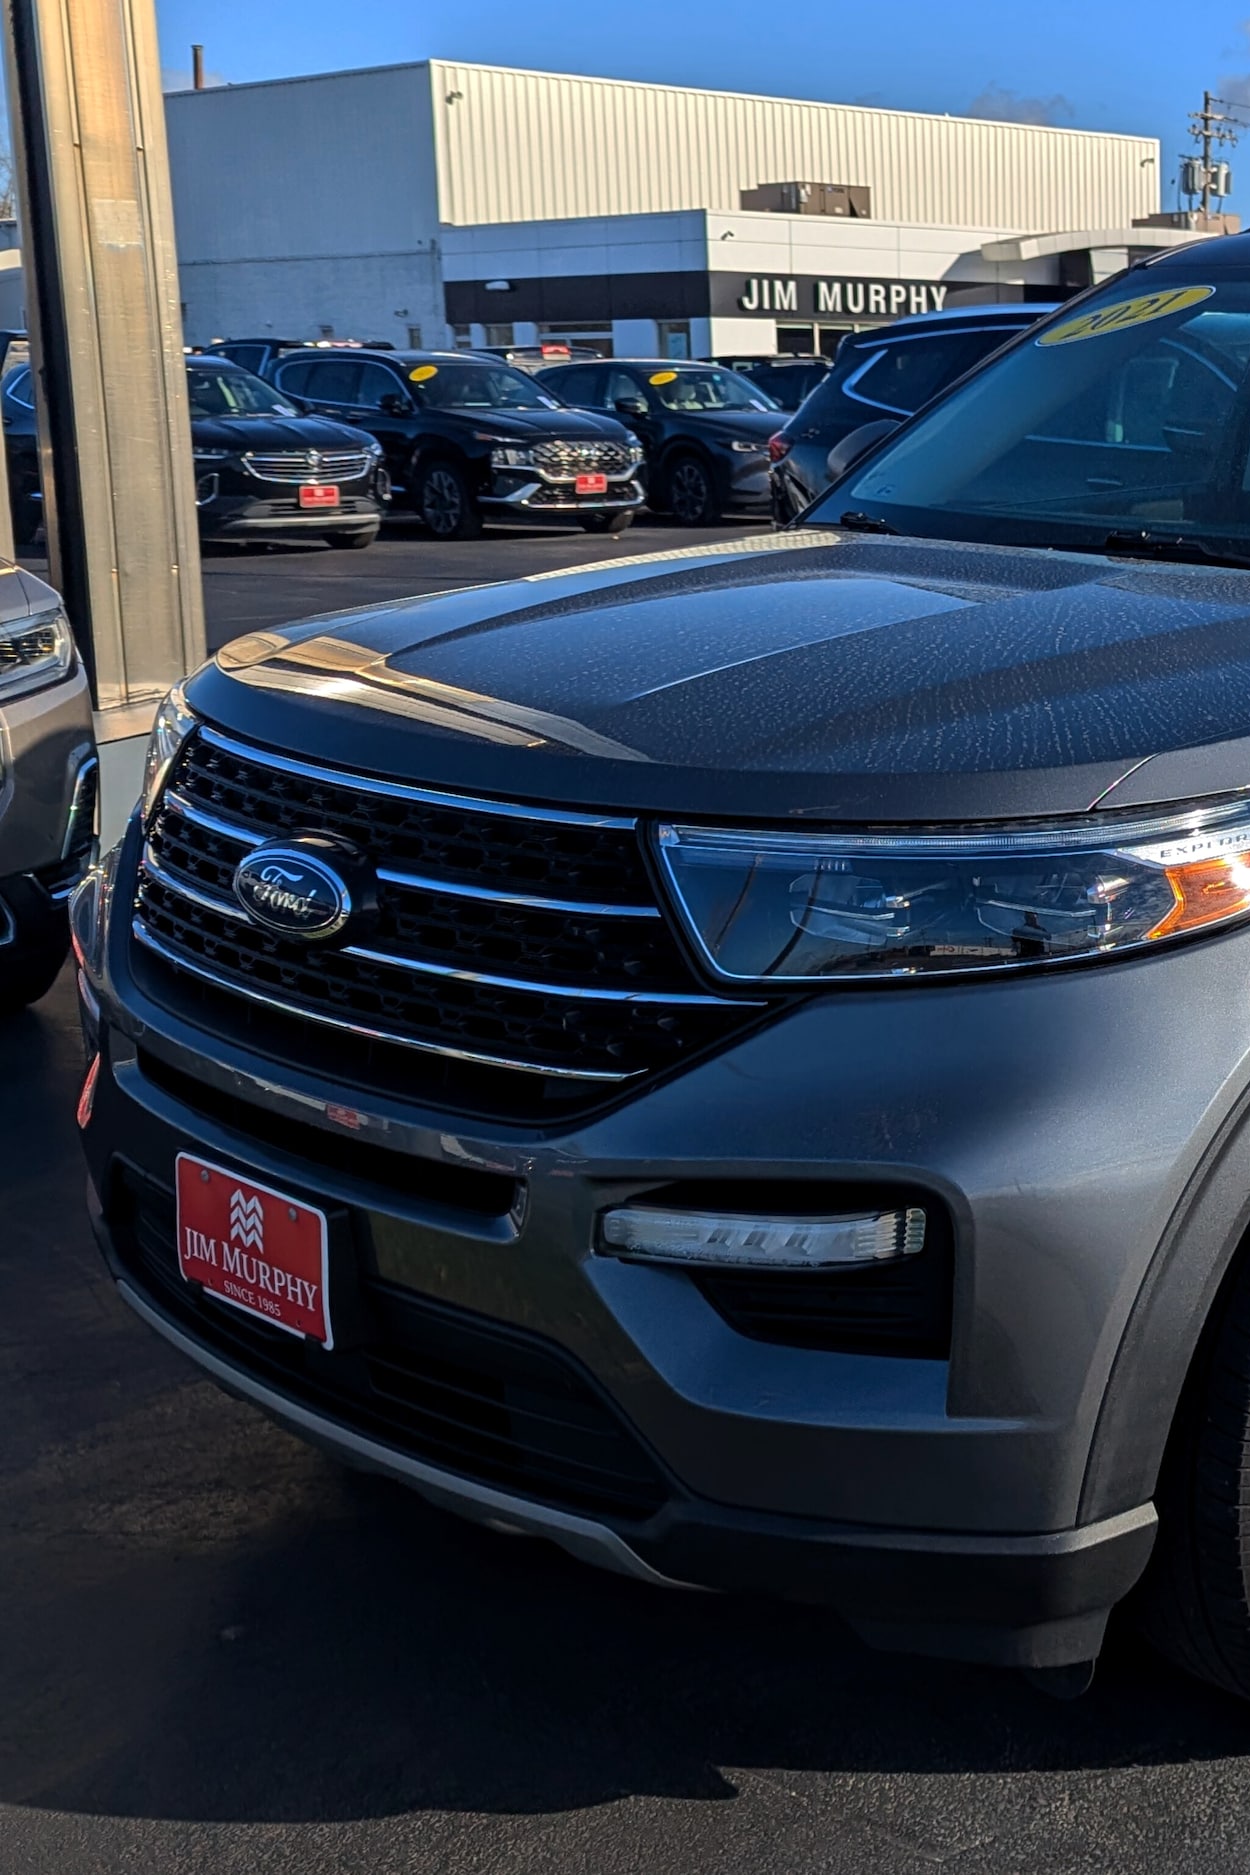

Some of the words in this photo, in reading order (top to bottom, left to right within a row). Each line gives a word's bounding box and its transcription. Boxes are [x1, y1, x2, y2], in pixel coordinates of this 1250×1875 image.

[742, 278, 797, 312] JIM
[818, 281, 948, 315] MURPHY
[184, 1227, 218, 1267] JIM
[222, 1241, 318, 1312] MURPHY
[223, 1280, 255, 1305] SINCE
[257, 1295, 281, 1317] 1985
